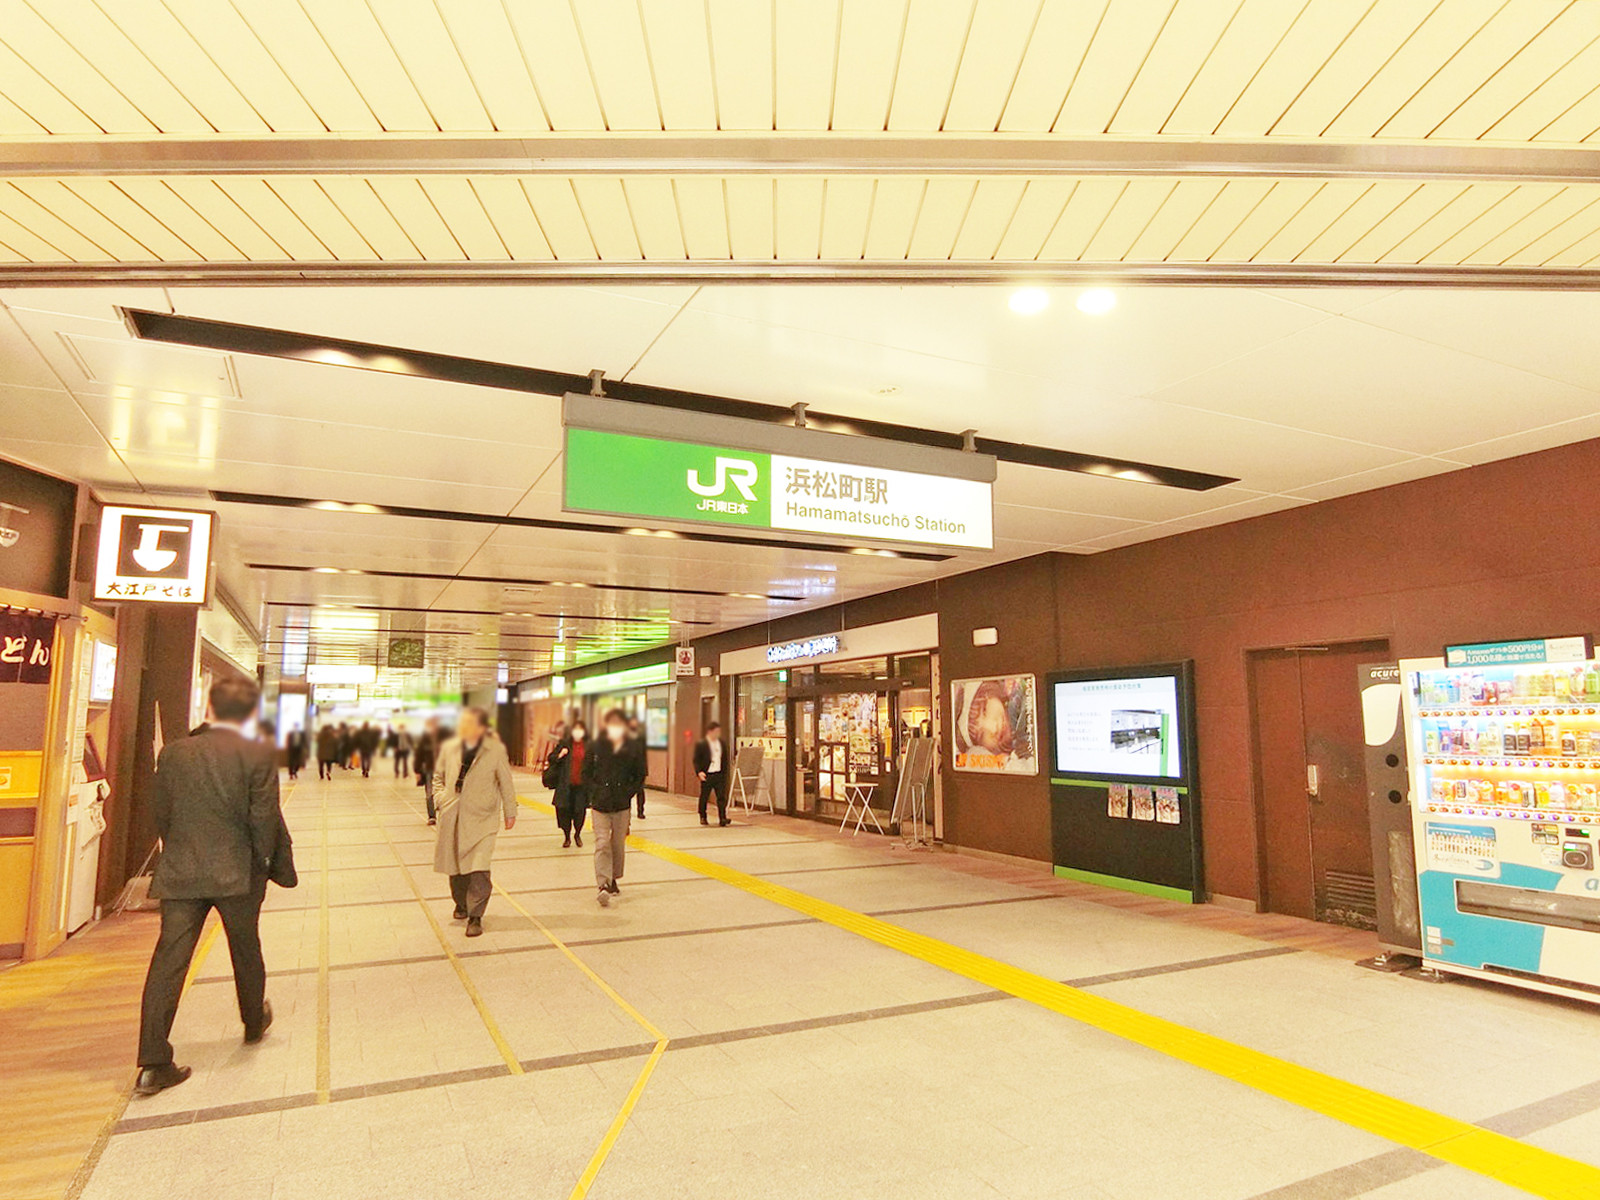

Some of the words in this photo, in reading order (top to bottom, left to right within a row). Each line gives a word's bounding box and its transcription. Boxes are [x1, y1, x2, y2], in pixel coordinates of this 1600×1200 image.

[687, 456, 758, 501] JR
[785, 466, 888, 504] 浜松町駅
[696, 499, 749, 515] JR東日本
[915, 515, 966, 534] Station
[1370, 669, 1400, 678] acure
